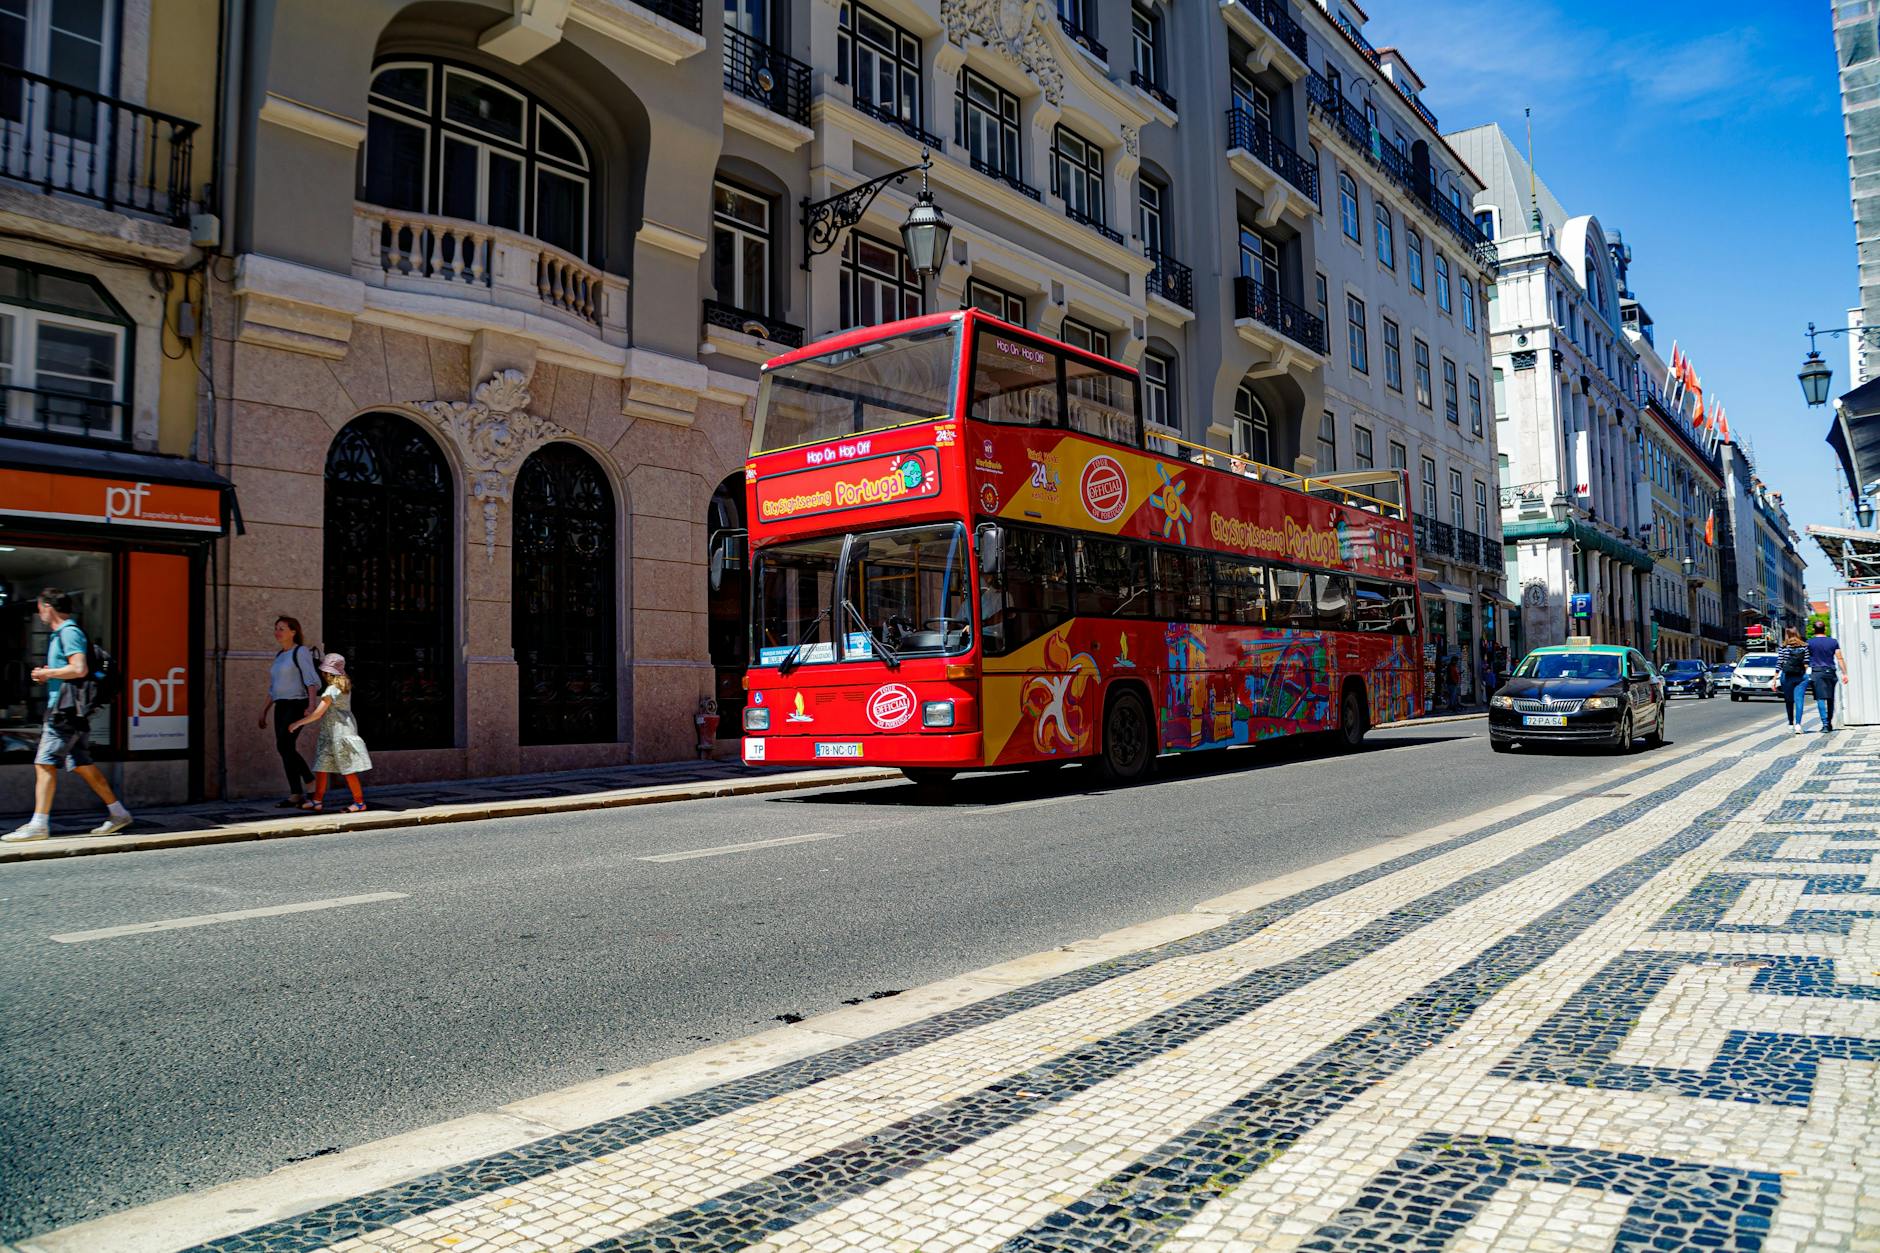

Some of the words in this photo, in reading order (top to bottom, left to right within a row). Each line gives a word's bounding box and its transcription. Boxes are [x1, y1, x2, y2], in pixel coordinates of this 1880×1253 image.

[996, 340, 1009, 353] Hop
[1010, 344, 1020, 356] On
[1022, 346, 1035, 361] Hop
[1035, 352, 1045, 364] Off
[807, 451, 823, 465] Hop
[824, 449, 836, 460] On
[839, 445, 856, 459] Hop
[856, 441, 871, 454] Off
[1031, 461, 1048, 489] 24
[763, 490, 832, 515] CitySightseeing
[835, 468, 908, 505] Portugal
[1089, 479, 1120, 498] OFFICIAL
[106, 482, 151, 523] pf
[1210, 510, 1286, 557] CitySightseeing
[1284, 515, 1342, 568] Portugal
[1576, 600, 1587, 612] P
[132, 667, 186, 727] pf
[875, 698, 908, 715] OFFICIAL
[754, 745, 764, 754] TP
[820, 745, 857, 755] 78-NC-07
